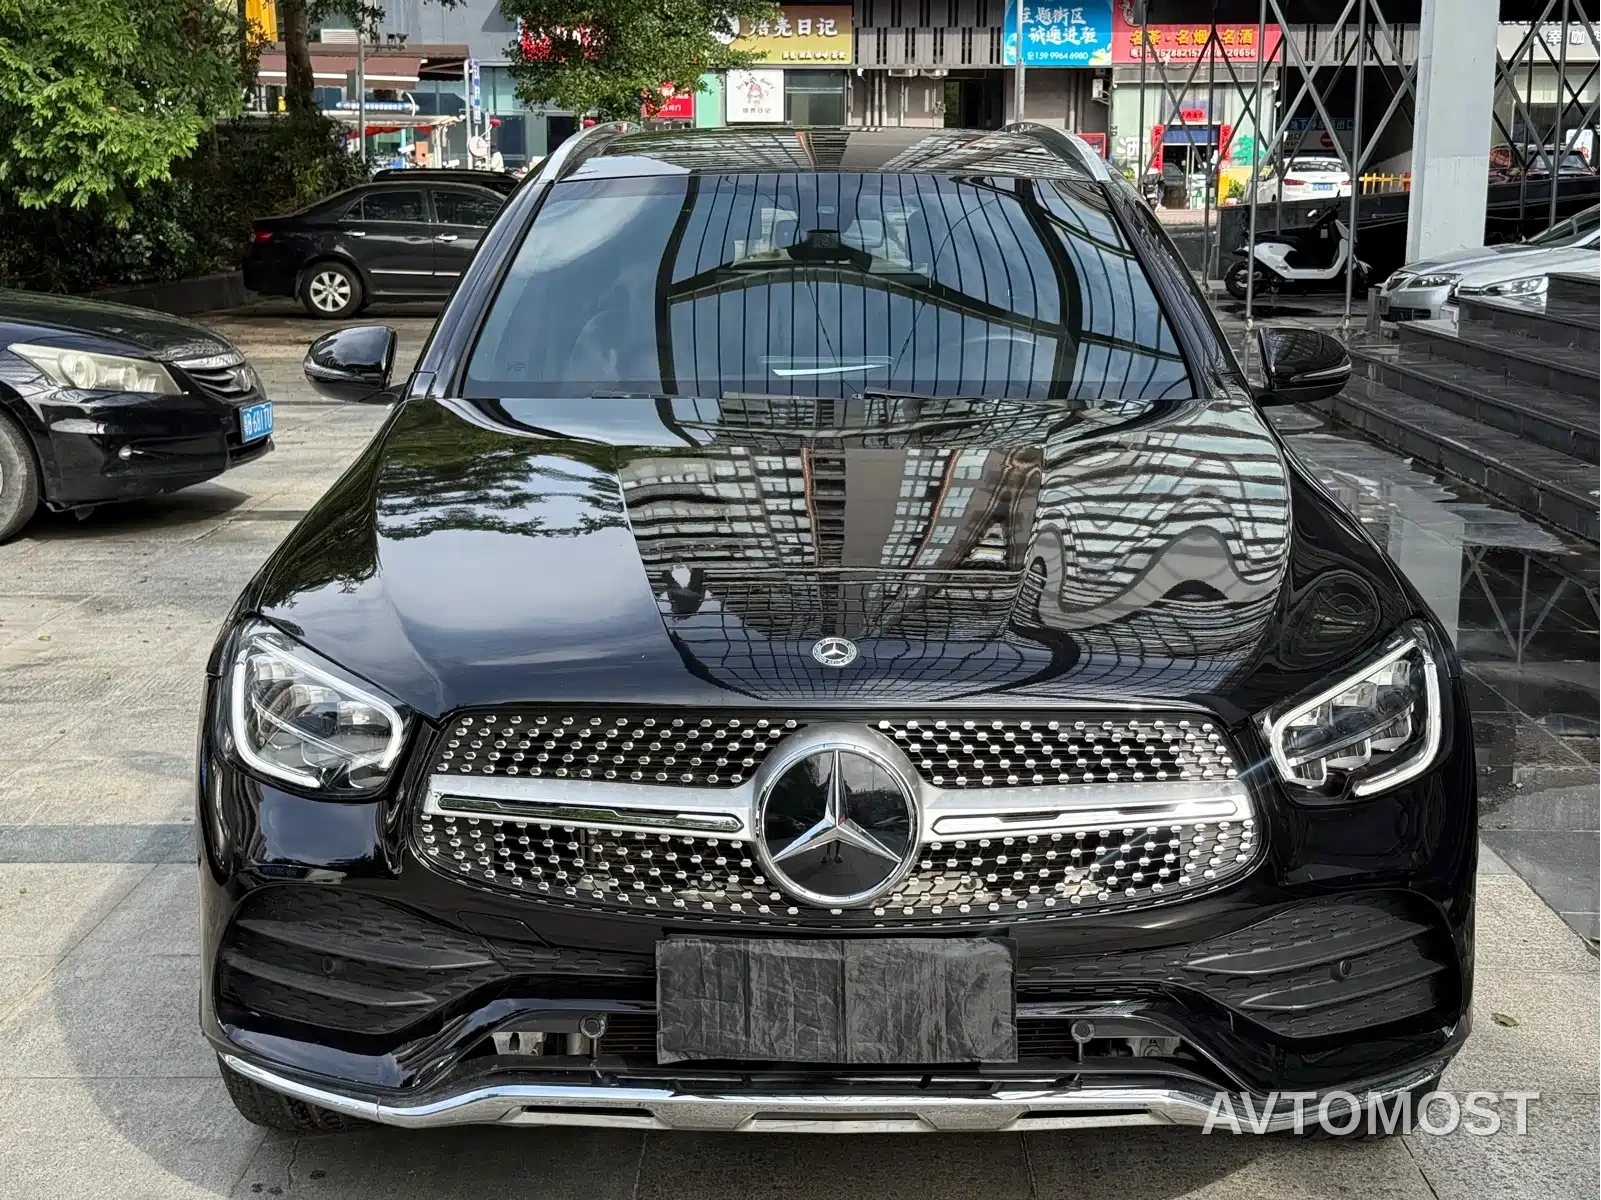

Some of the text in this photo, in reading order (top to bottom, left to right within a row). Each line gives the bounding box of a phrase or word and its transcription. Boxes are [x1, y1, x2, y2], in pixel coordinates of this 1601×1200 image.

[1020, 7, 1087, 27] 主题街区
[1028, 25, 1098, 46] 诚邀进驻
